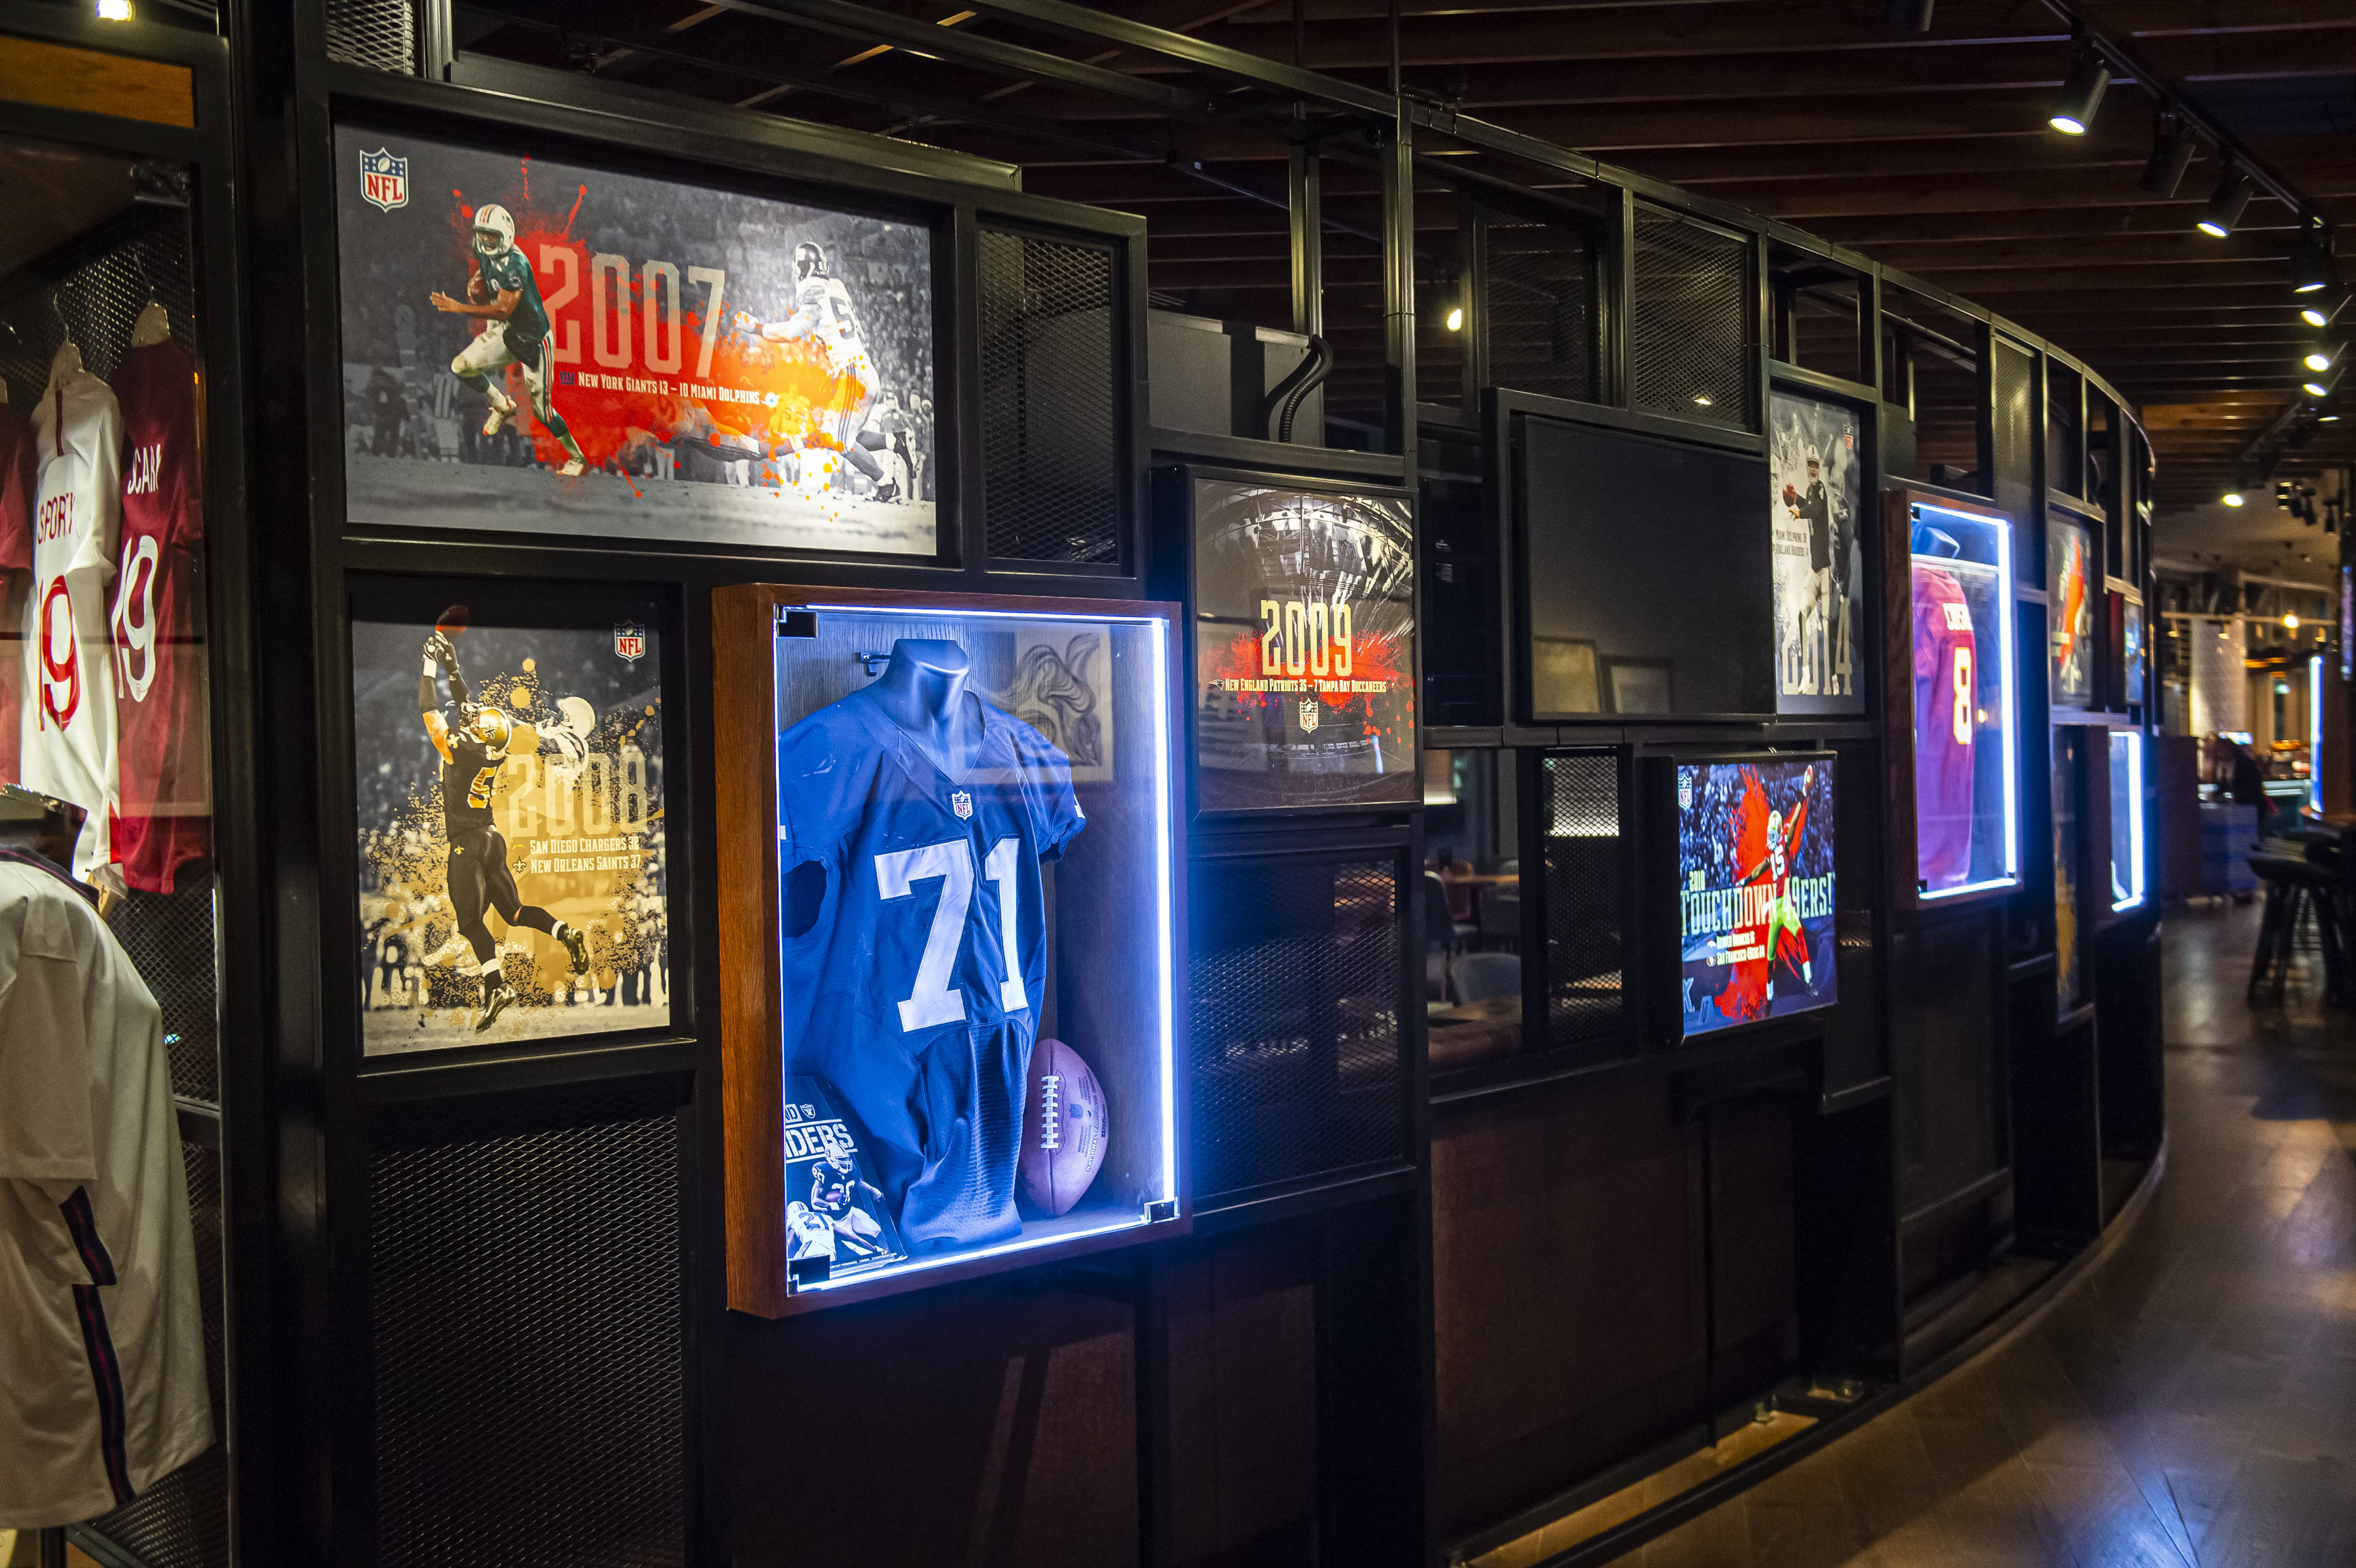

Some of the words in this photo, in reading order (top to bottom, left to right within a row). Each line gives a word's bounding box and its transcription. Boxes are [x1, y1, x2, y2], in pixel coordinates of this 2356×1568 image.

[366, 174, 403, 203] NFL
[540, 243, 725, 378] 2007
[578, 372, 599, 387] NEW
[601, 374, 624, 391] YORK
[626, 377, 657, 394] GIANTS
[659, 380, 668, 395] 13
[679, 383, 688, 397] 10
[690, 383, 717, 400] MIAMI
[719, 386, 760, 405] DOLPHINS
[111, 535, 158, 703] 19
[1260, 599, 1352, 677] 2009
[39, 575, 80, 732] 19
[618, 638, 642, 656] NFL
[1225, 678, 1240, 691] NEW
[1241, 679, 1268, 692] ENGLAND
[1270, 679, 1298, 692] PATRIOTS
[1299, 679, 1307, 692] 35
[1314, 679, 1318, 692] 7
[1319, 679, 1338, 692] TAMPA
[1339, 680, 1350, 692] BAY
[1351, 679, 1387, 692] BUCCANEERS
[1953, 647, 1972, 745] 8
[1302, 713, 1316, 726] NFL
[507, 752, 649, 838] 2008
[530, 840, 548, 854] SAN
[550, 839, 577, 853] DIEGO
[580, 837, 627, 853] CHARGERS
[531, 859, 551, 874] NEW
[554, 857, 595, 872] ORLEANS
[597, 856, 628, 871] SAINTS
[630, 854, 641, 868] 37
[1770, 844, 1785, 882] 15
[1688, 870, 1705, 892] 2010
[1680, 883, 1777, 936] TOUCHDOWN
[874, 838, 1028, 1033] 71
[1086, 1134, 1099, 1172] NATIONAL
